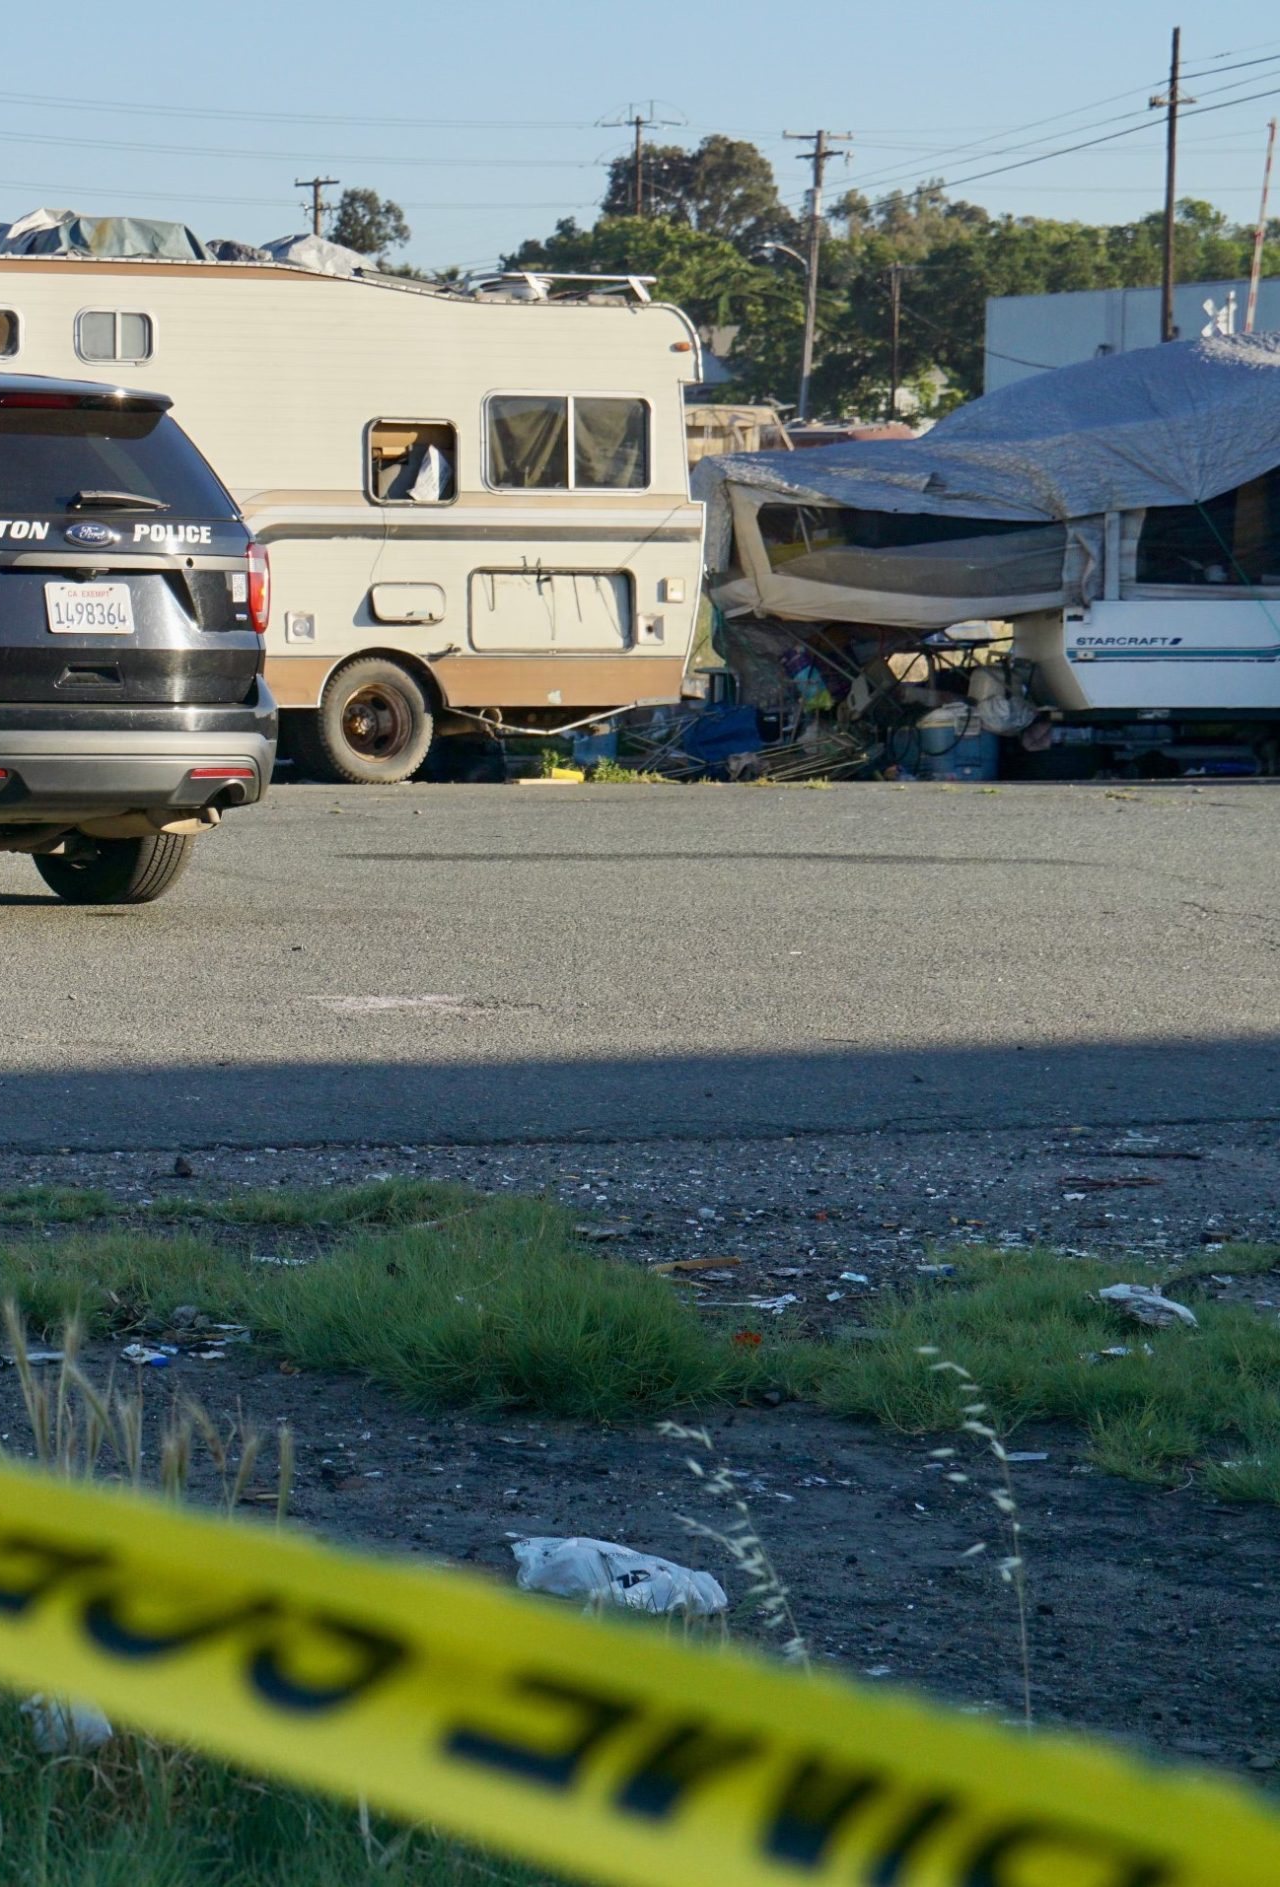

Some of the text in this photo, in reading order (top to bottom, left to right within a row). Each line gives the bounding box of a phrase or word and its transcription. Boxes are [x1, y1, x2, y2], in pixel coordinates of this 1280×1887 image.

[132, 523, 213, 545] POLICE
[67, 590, 110, 598] CA EXEMPT
[54, 602, 127, 626] 1498364
[1076, 637, 1169, 646] STARCRAFT
